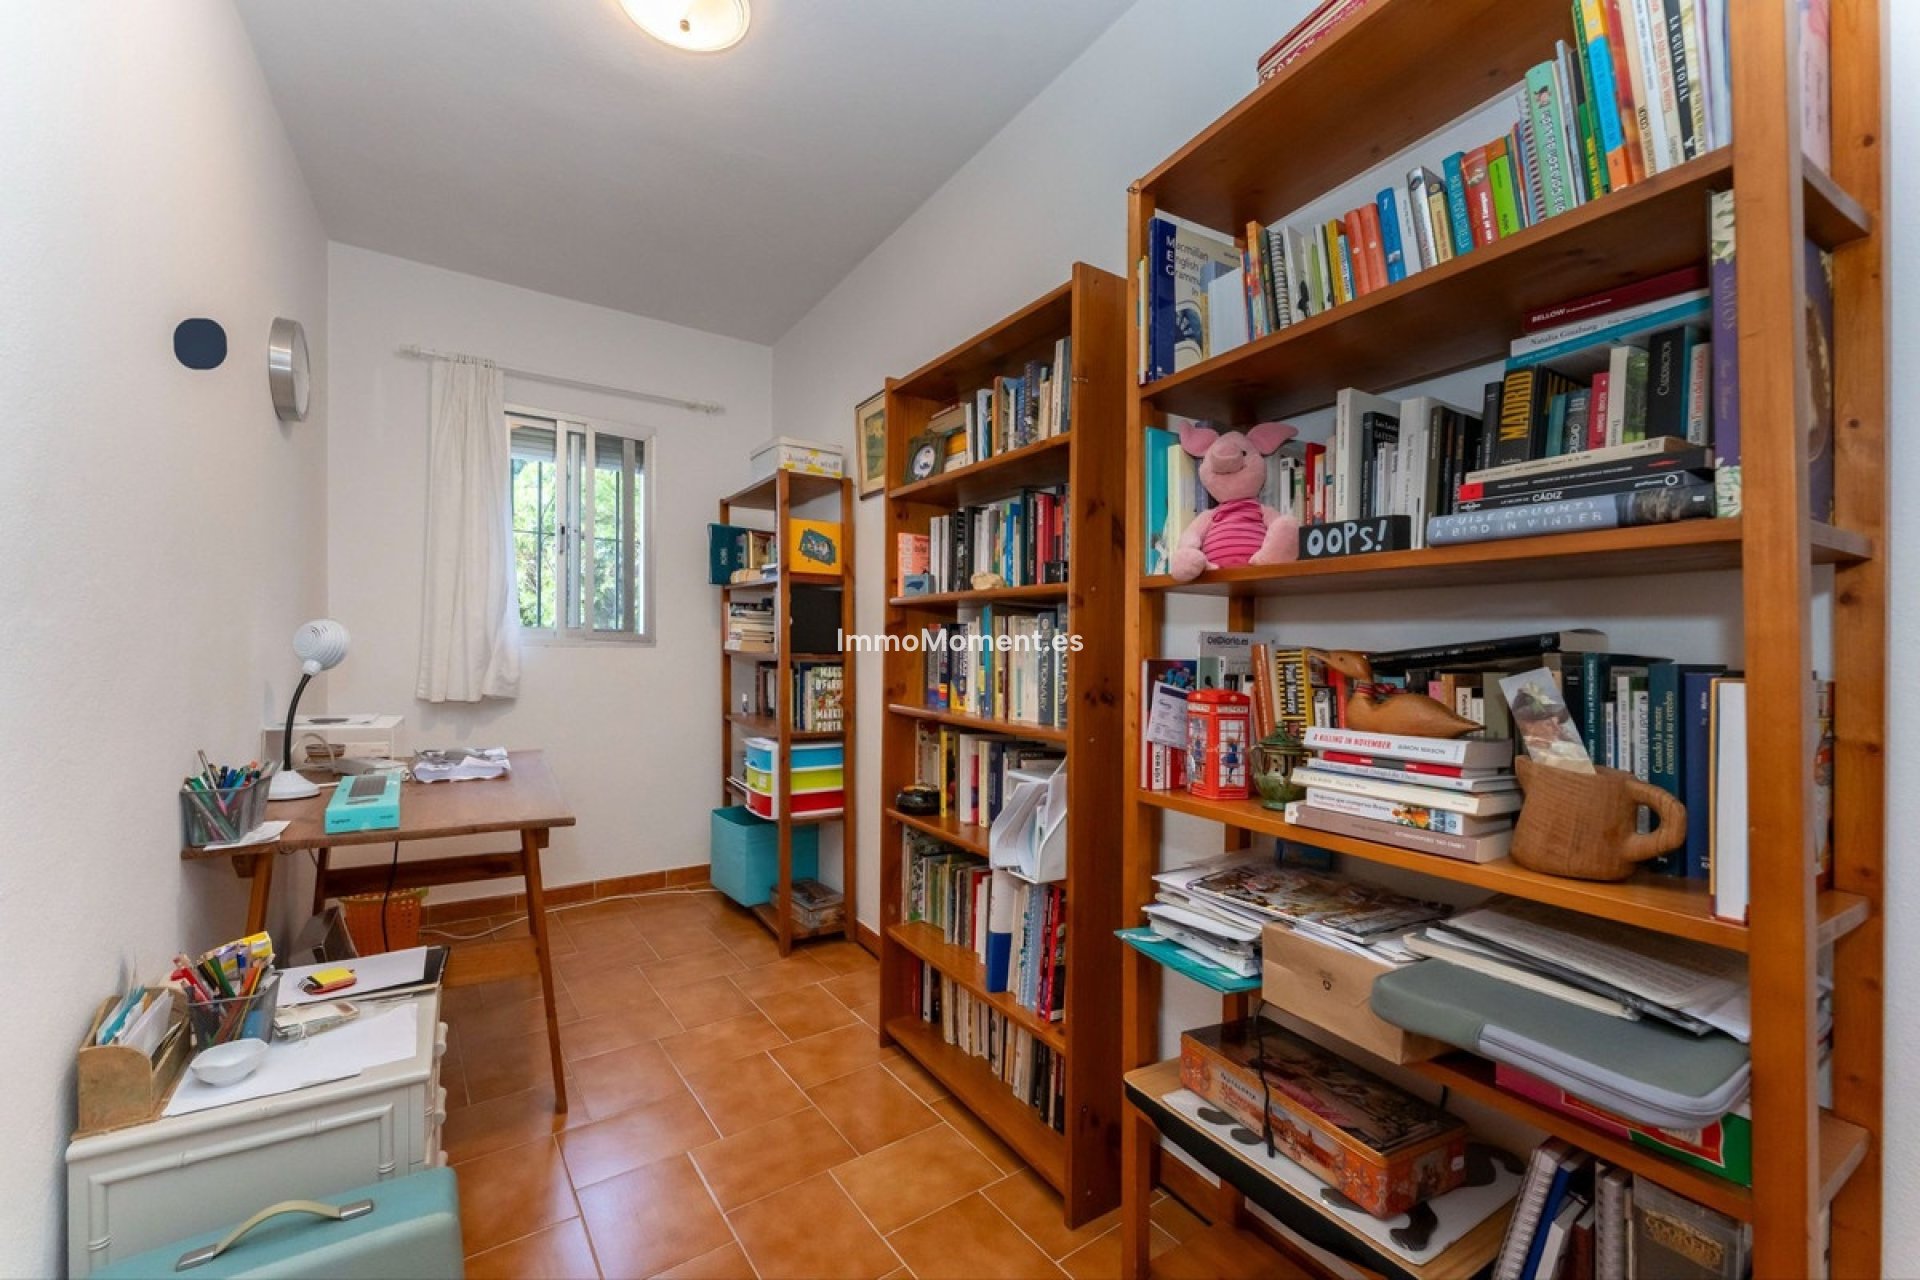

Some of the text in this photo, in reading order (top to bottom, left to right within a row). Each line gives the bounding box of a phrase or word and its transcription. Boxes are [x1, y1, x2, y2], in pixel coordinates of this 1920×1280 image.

[1499, 369, 1533, 441] MADRID
[1307, 520, 1388, 556] OOPS!
[1452, 524, 1490, 537] BIRD
[1527, 511, 1602, 527] WINTER
[1354, 738, 1393, 751] NOVEMBER
